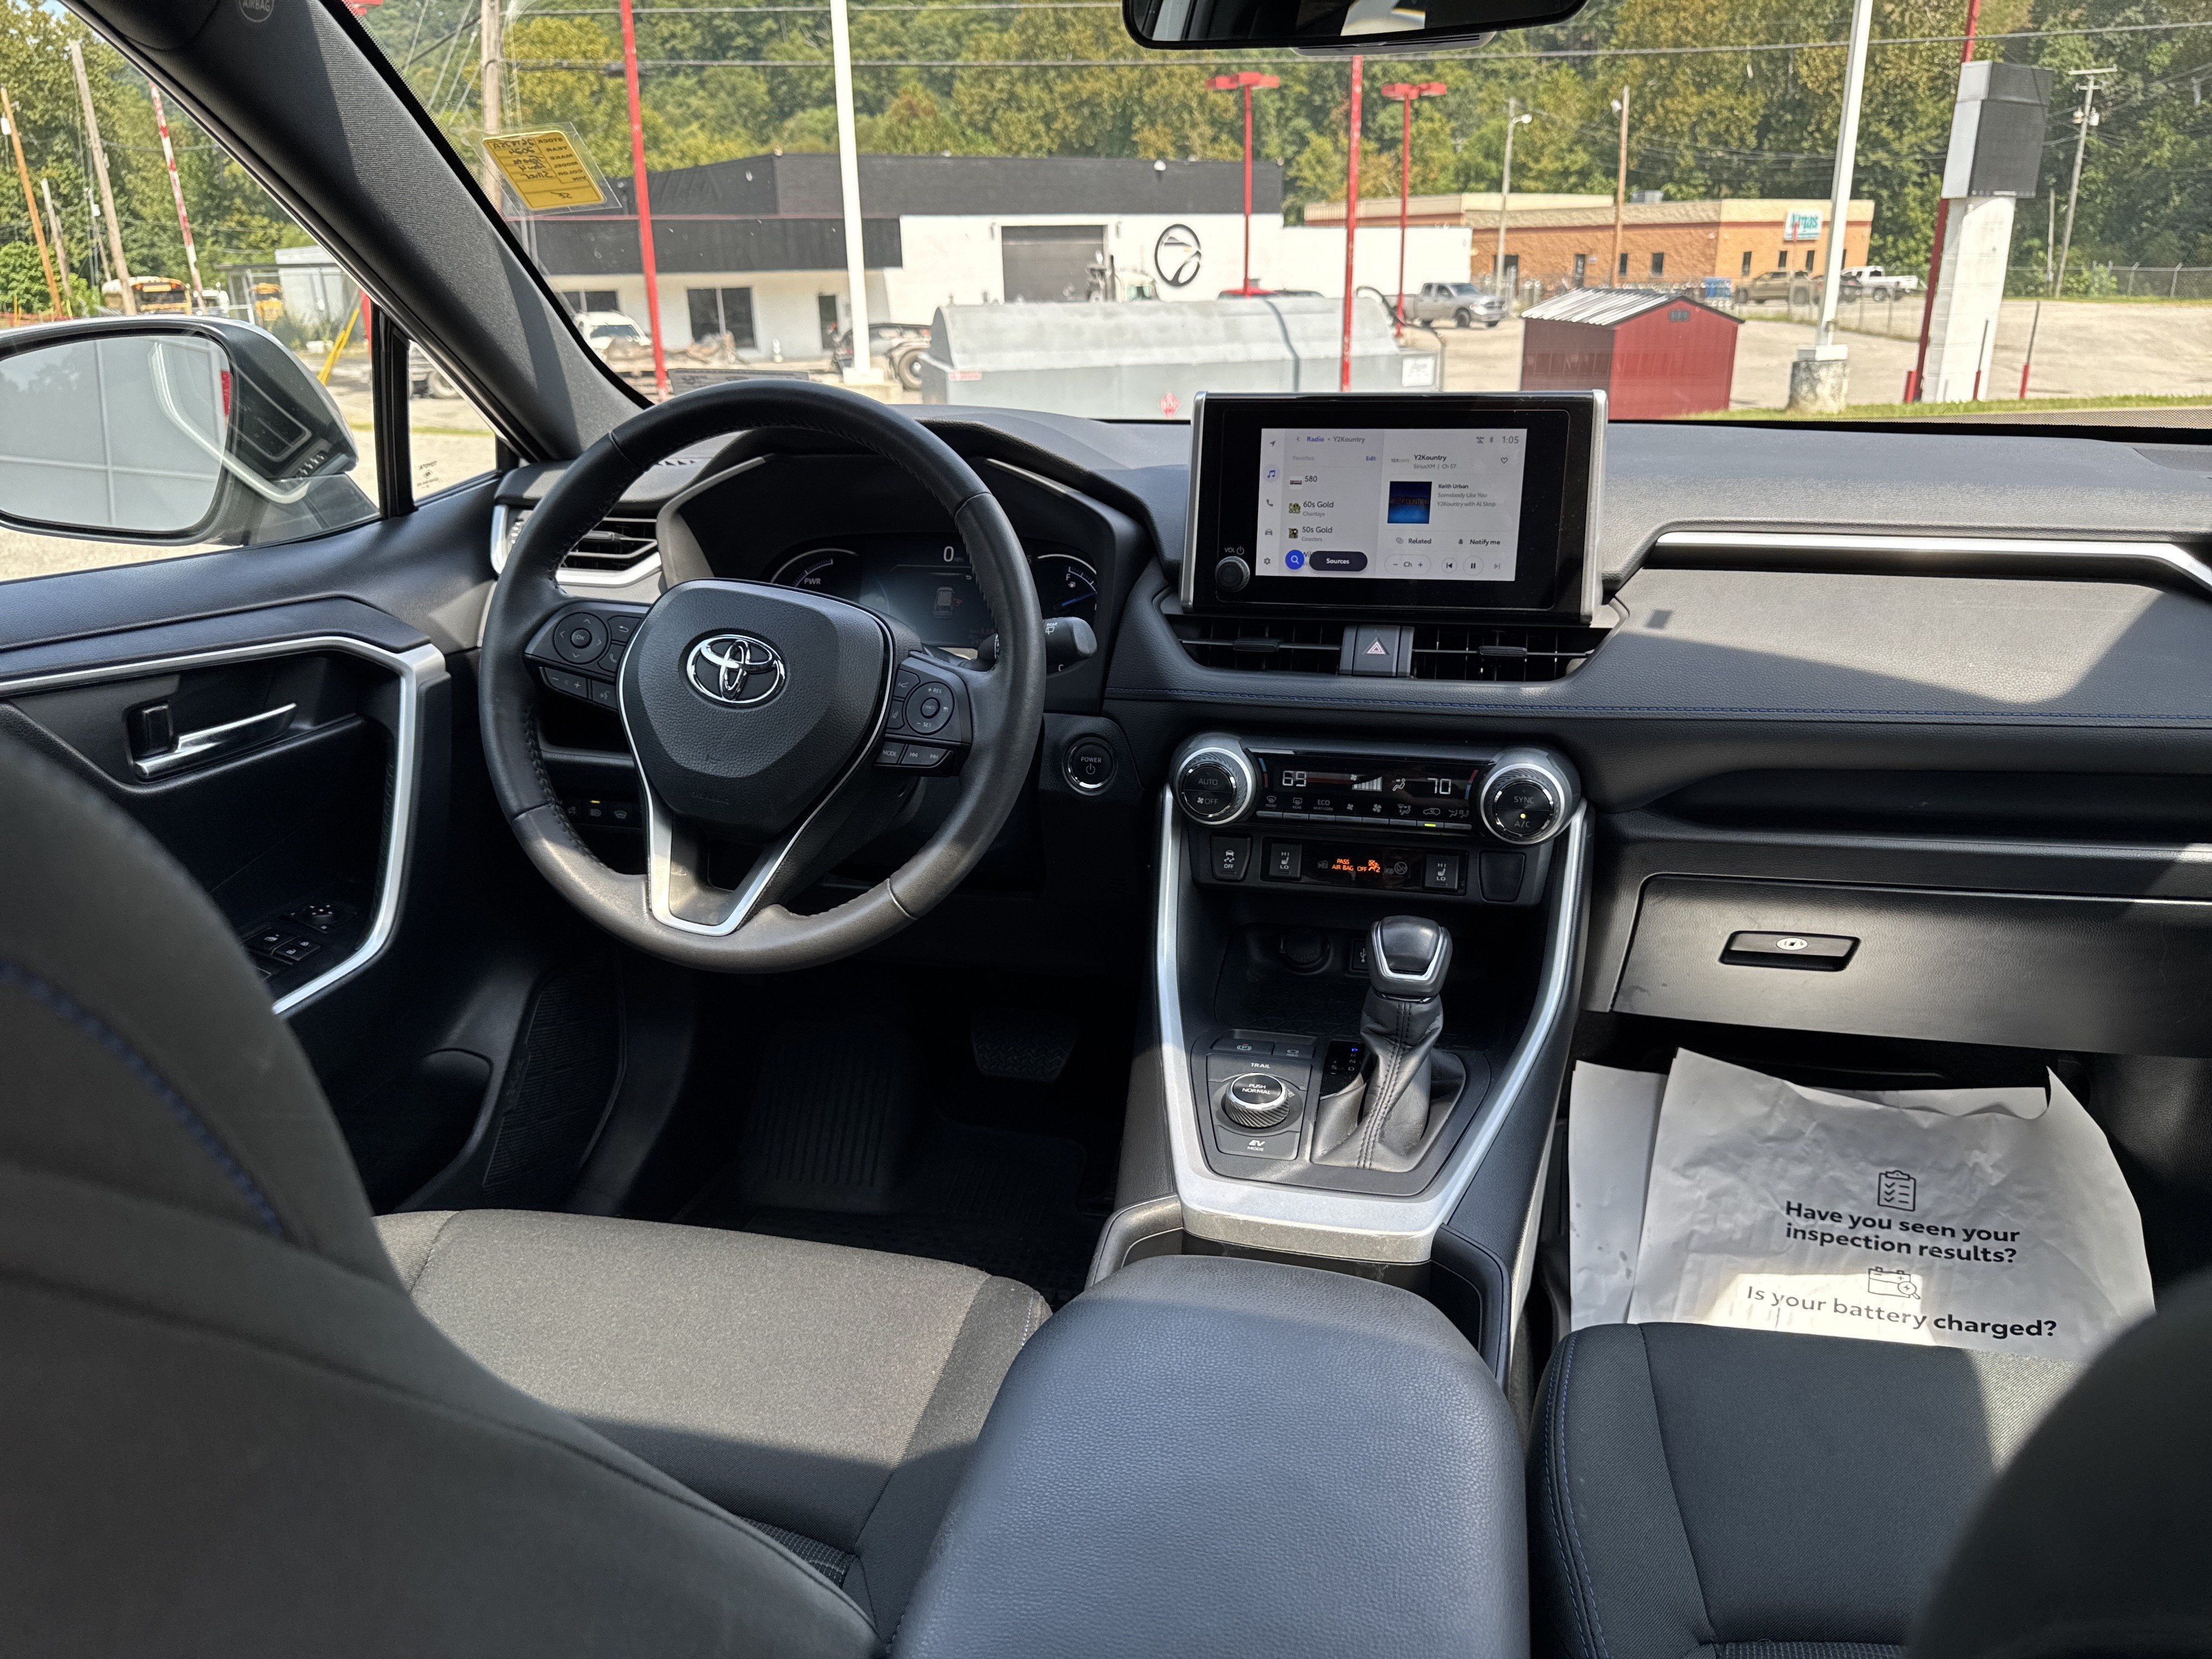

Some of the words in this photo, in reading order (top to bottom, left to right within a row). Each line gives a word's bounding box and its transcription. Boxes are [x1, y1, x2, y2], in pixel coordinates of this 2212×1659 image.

[944, 546, 954, 562] 0
[1427, 777, 1452, 794] 70
[1514, 820, 1531, 828] A/C
[1785, 1201, 1843, 1223] Have
[1848, 1212, 1892, 1230] you
[1899, 1220, 1956, 1238] seen
[1962, 1226, 2021, 1243] your
[1785, 1223, 1911, 1255] inspection
[1918, 1243, 2018, 1263] results?
[1747, 1285, 1765, 1301] Is
[1771, 1291, 1827, 1314] your
[1833, 1297, 1928, 1330] battery
[1933, 1313, 2058, 1340] charged?
